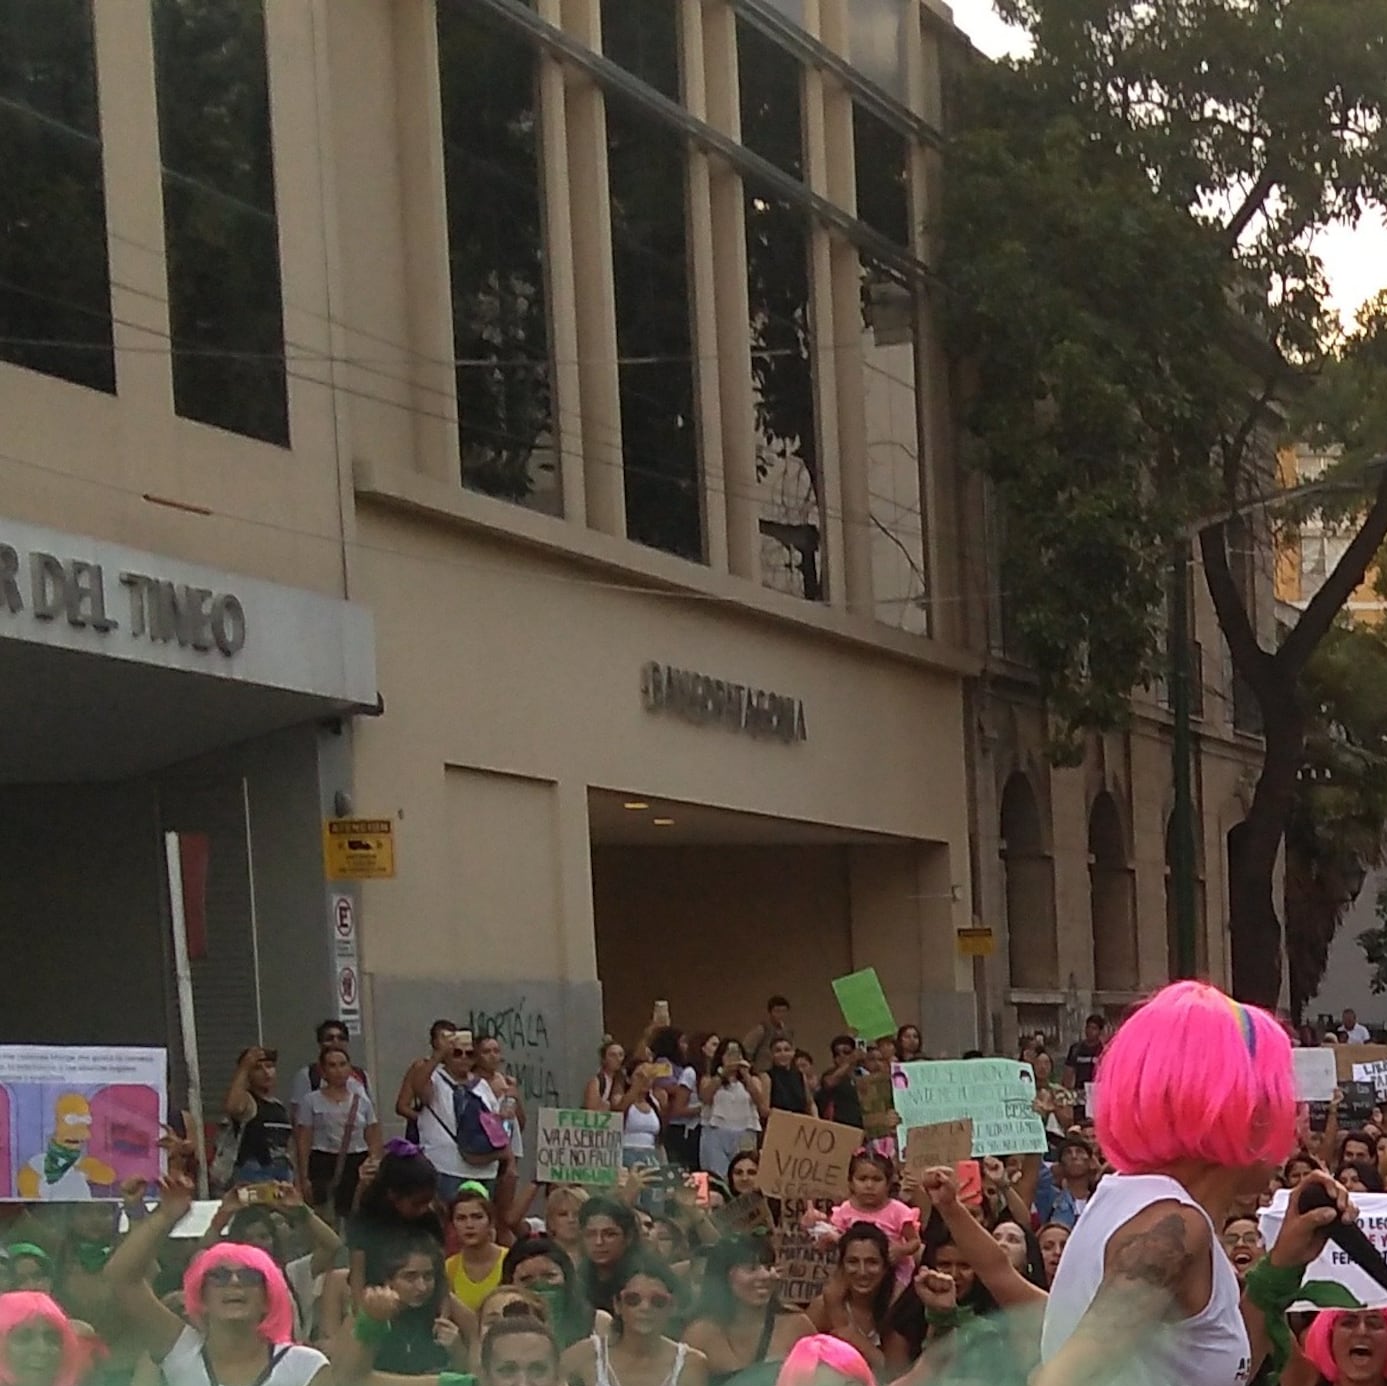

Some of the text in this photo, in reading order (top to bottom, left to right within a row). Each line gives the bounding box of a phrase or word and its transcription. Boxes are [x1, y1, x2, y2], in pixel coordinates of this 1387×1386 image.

[29, 551, 120, 633] DEL
[558, 1111, 612, 1130] FELIZ
[793, 1125, 836, 1154] NO
[538, 1148, 564, 1167] QUE
[570, 1149, 586, 1166] NO
[775, 1150, 842, 1186] VIOLE
